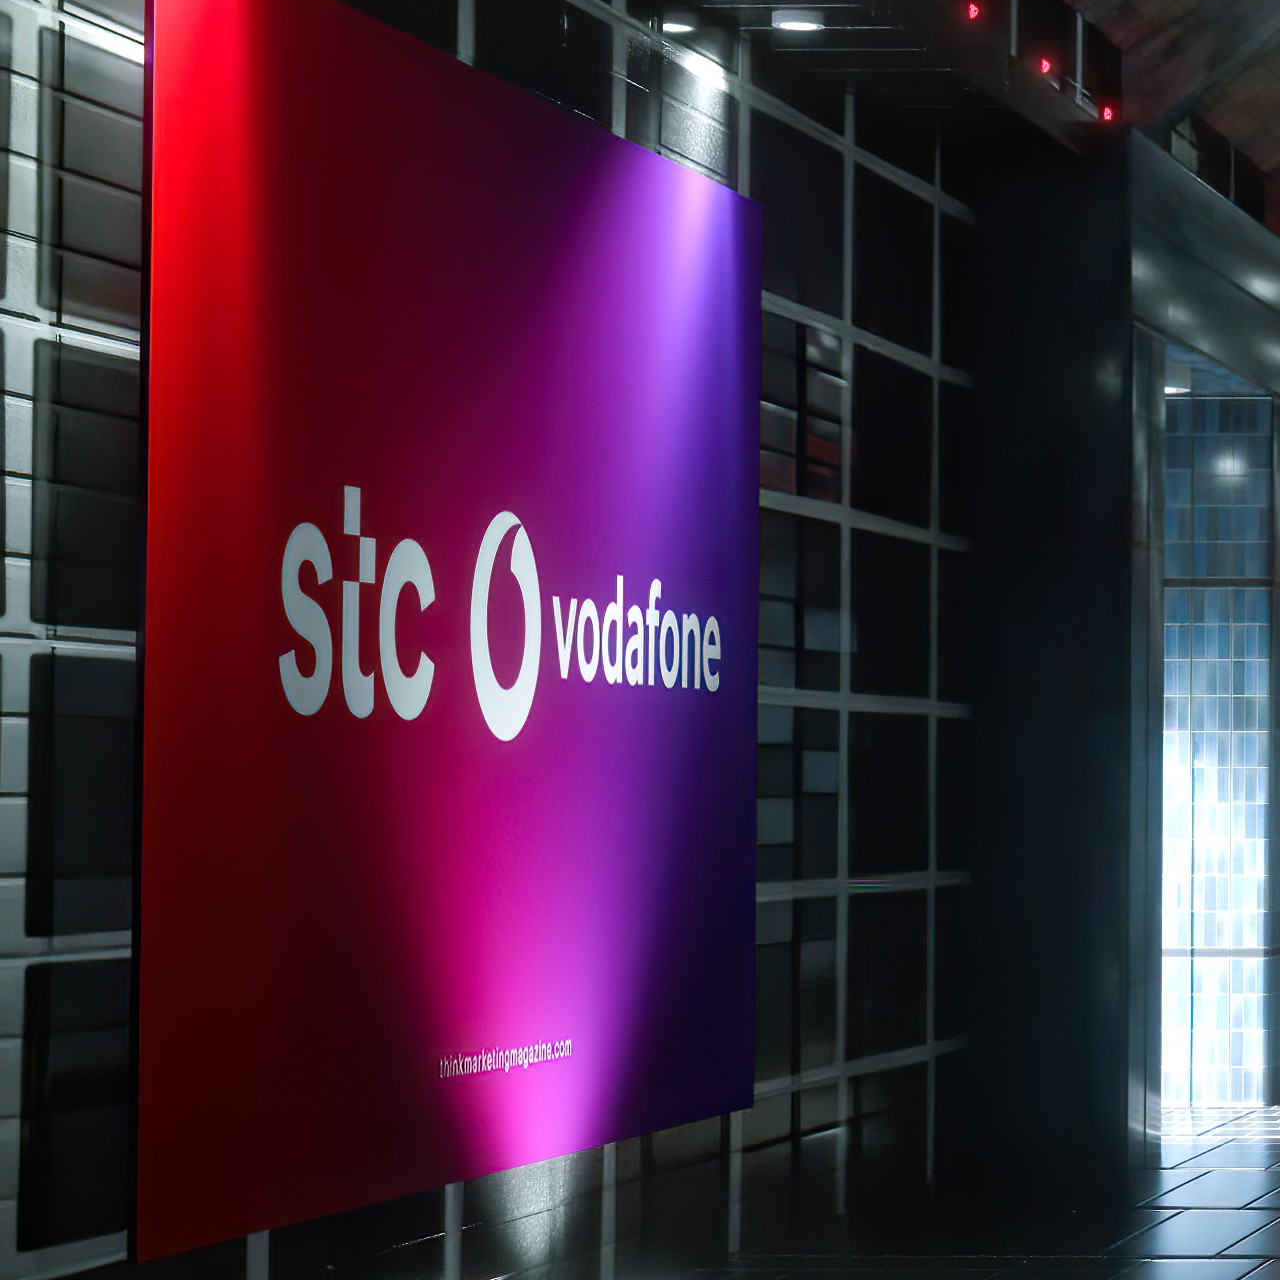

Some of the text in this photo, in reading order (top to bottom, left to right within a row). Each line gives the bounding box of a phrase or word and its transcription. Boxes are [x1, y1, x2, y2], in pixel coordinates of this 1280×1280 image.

[279, 485, 721, 720] stc vodafone
[439, 1039, 572, 1078] thinkmarketingmagazine.com
